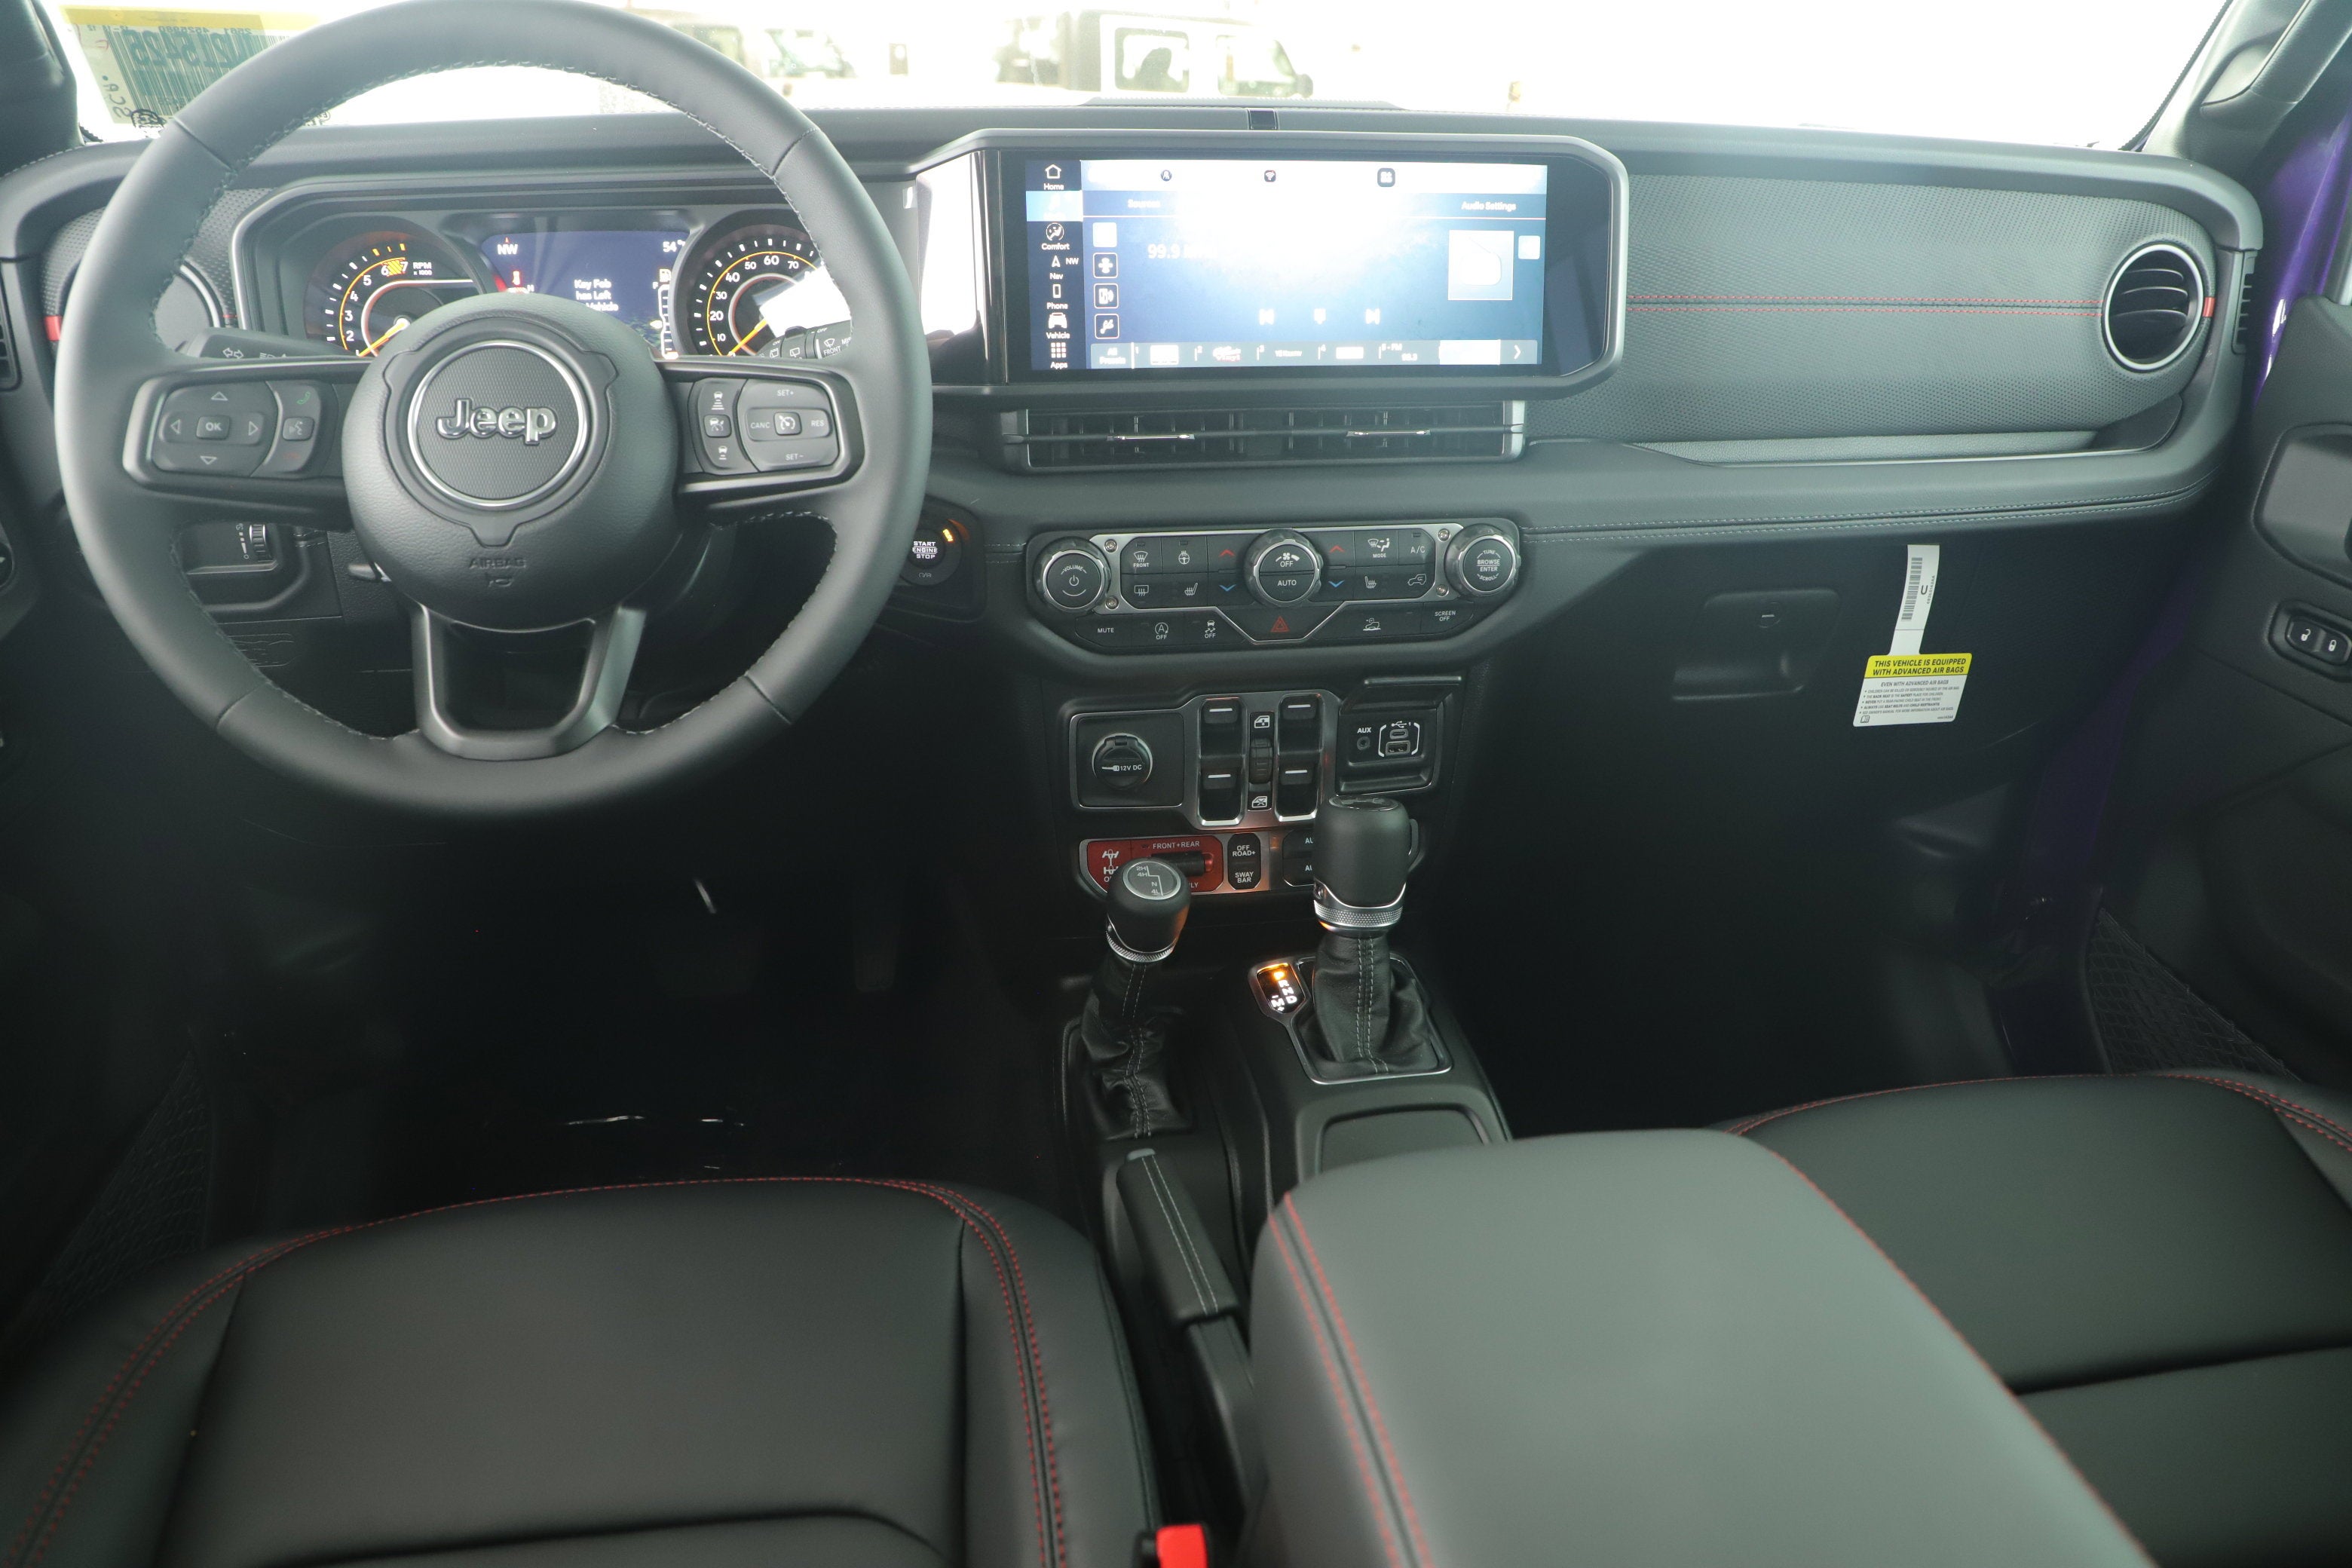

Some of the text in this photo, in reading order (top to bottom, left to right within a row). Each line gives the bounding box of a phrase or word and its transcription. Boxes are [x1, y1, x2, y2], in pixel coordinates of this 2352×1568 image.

[1461, 201, 1517, 213] Audio Settings
[498, 243, 518, 255] NW
[1041, 243, 1070, 251] Comfort
[1147, 243, 1181, 259] 99.9
[764, 256, 779, 265] 60
[788, 260, 799, 269] 70
[1065, 257, 1080, 265] NW
[381, 265, 389, 276] 6
[400, 262, 409, 272] 7
[745, 261, 757, 271] 50
[363, 275, 372, 286] 5
[726, 272, 740, 283] 40
[574, 278, 611, 290] Key Fob
[350, 291, 358, 302] 4
[576, 289, 611, 300] has Left
[716, 291, 727, 301] 30
[1046, 302, 1068, 310] Phone
[345, 311, 353, 321] 3
[709, 311, 724, 321] 20
[346, 331, 354, 341] 2
[717, 333, 726, 341] 10
[1046, 331, 1070, 339] Vehicle
[823, 345, 841, 357] FRONT
[1050, 361, 1068, 370] Apps
[205, 422, 222, 432] OK
[436, 398, 557, 446] Jeep
[1410, 546, 1426, 554] A/C
[1063, 564, 1085, 573] VOLUME
[1893, 659, 1922, 667] VEHICLE
[1893, 667, 1931, 675] ADVANCED
[1279, 979, 1290, 988] R
[1282, 987, 1294, 996] N
[1271, 998, 1285, 1007] M
[1285, 995, 1297, 1004] D
